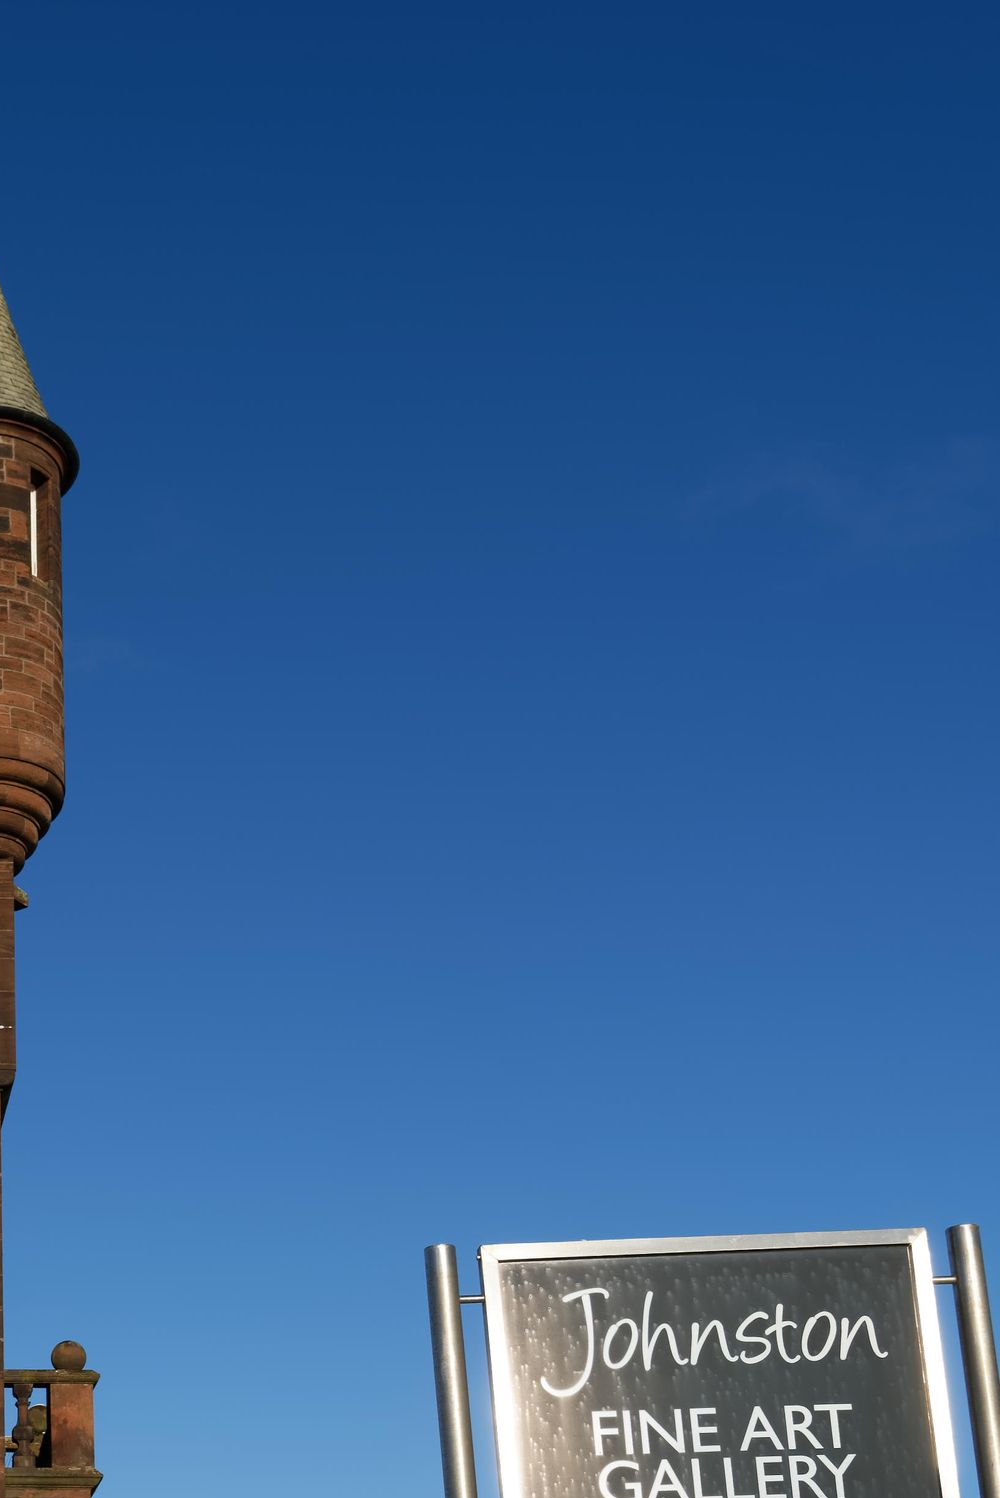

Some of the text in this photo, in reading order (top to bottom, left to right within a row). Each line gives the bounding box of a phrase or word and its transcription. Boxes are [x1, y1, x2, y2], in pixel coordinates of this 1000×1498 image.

[540, 1287, 888, 1398] Johnston
[591, 1403, 852, 1455] FINE ART
